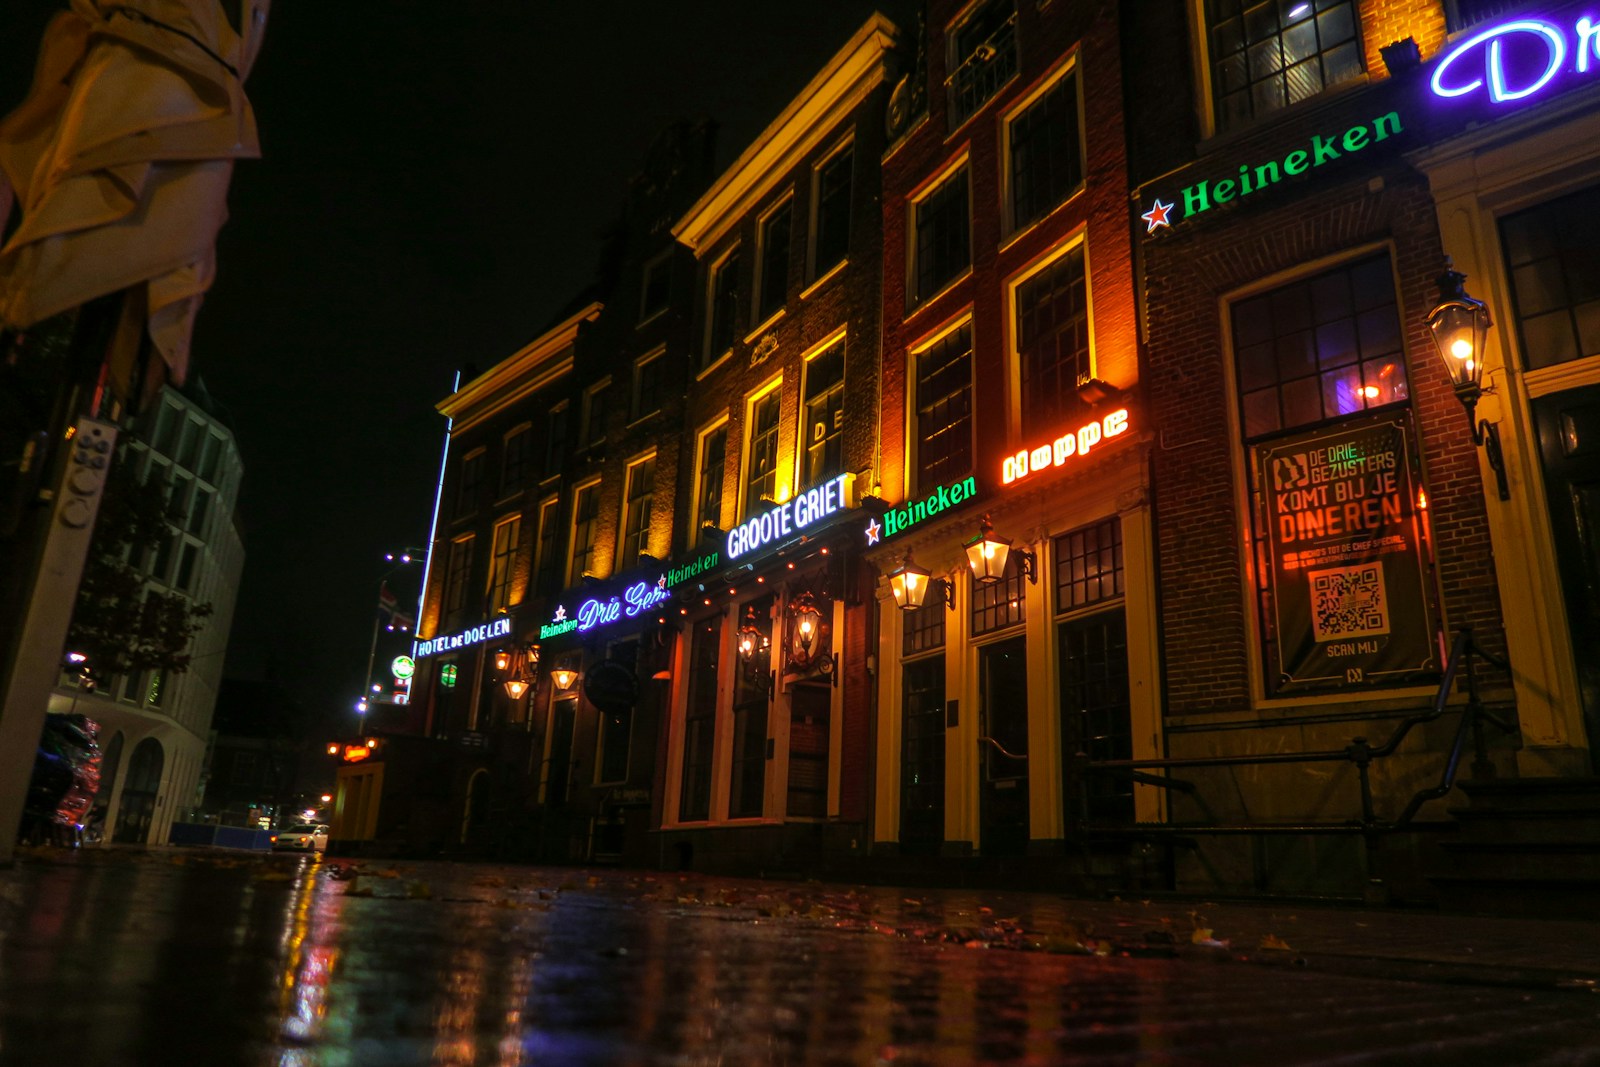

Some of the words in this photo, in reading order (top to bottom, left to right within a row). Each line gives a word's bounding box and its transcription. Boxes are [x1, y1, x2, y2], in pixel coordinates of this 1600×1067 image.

[1181, 110, 1404, 219] Heineken
[1002, 408, 1129, 485] Hoppe
[1309, 449, 1326, 468] DE
[1327, 442, 1358, 463] DRIE
[1311, 451, 1396, 484] GEZUSTERS
[883, 476, 977, 538] Heineken
[1278, 485, 1328, 513] KOMT
[1335, 477, 1365, 503] BIJ
[1372, 472, 1397, 496] JE
[727, 502, 792, 560] GROOTE
[795, 473, 849, 529] GRIET
[1279, 494, 1402, 543] DINEREN
[1328, 545, 1341, 556] TOT
[1341, 543, 1352, 553] DE
[1352, 540, 1372, 552] CHEF
[667, 552, 719, 588] Heineken
[540, 618, 578, 640] Heineken
[578, 597, 620, 631] Drie
[418, 635, 452, 657] HOTEL
[464, 618, 511, 646] DOELEN
[1327, 643, 1356, 658] SCAN
[1358, 640, 1378, 654] MIJ
